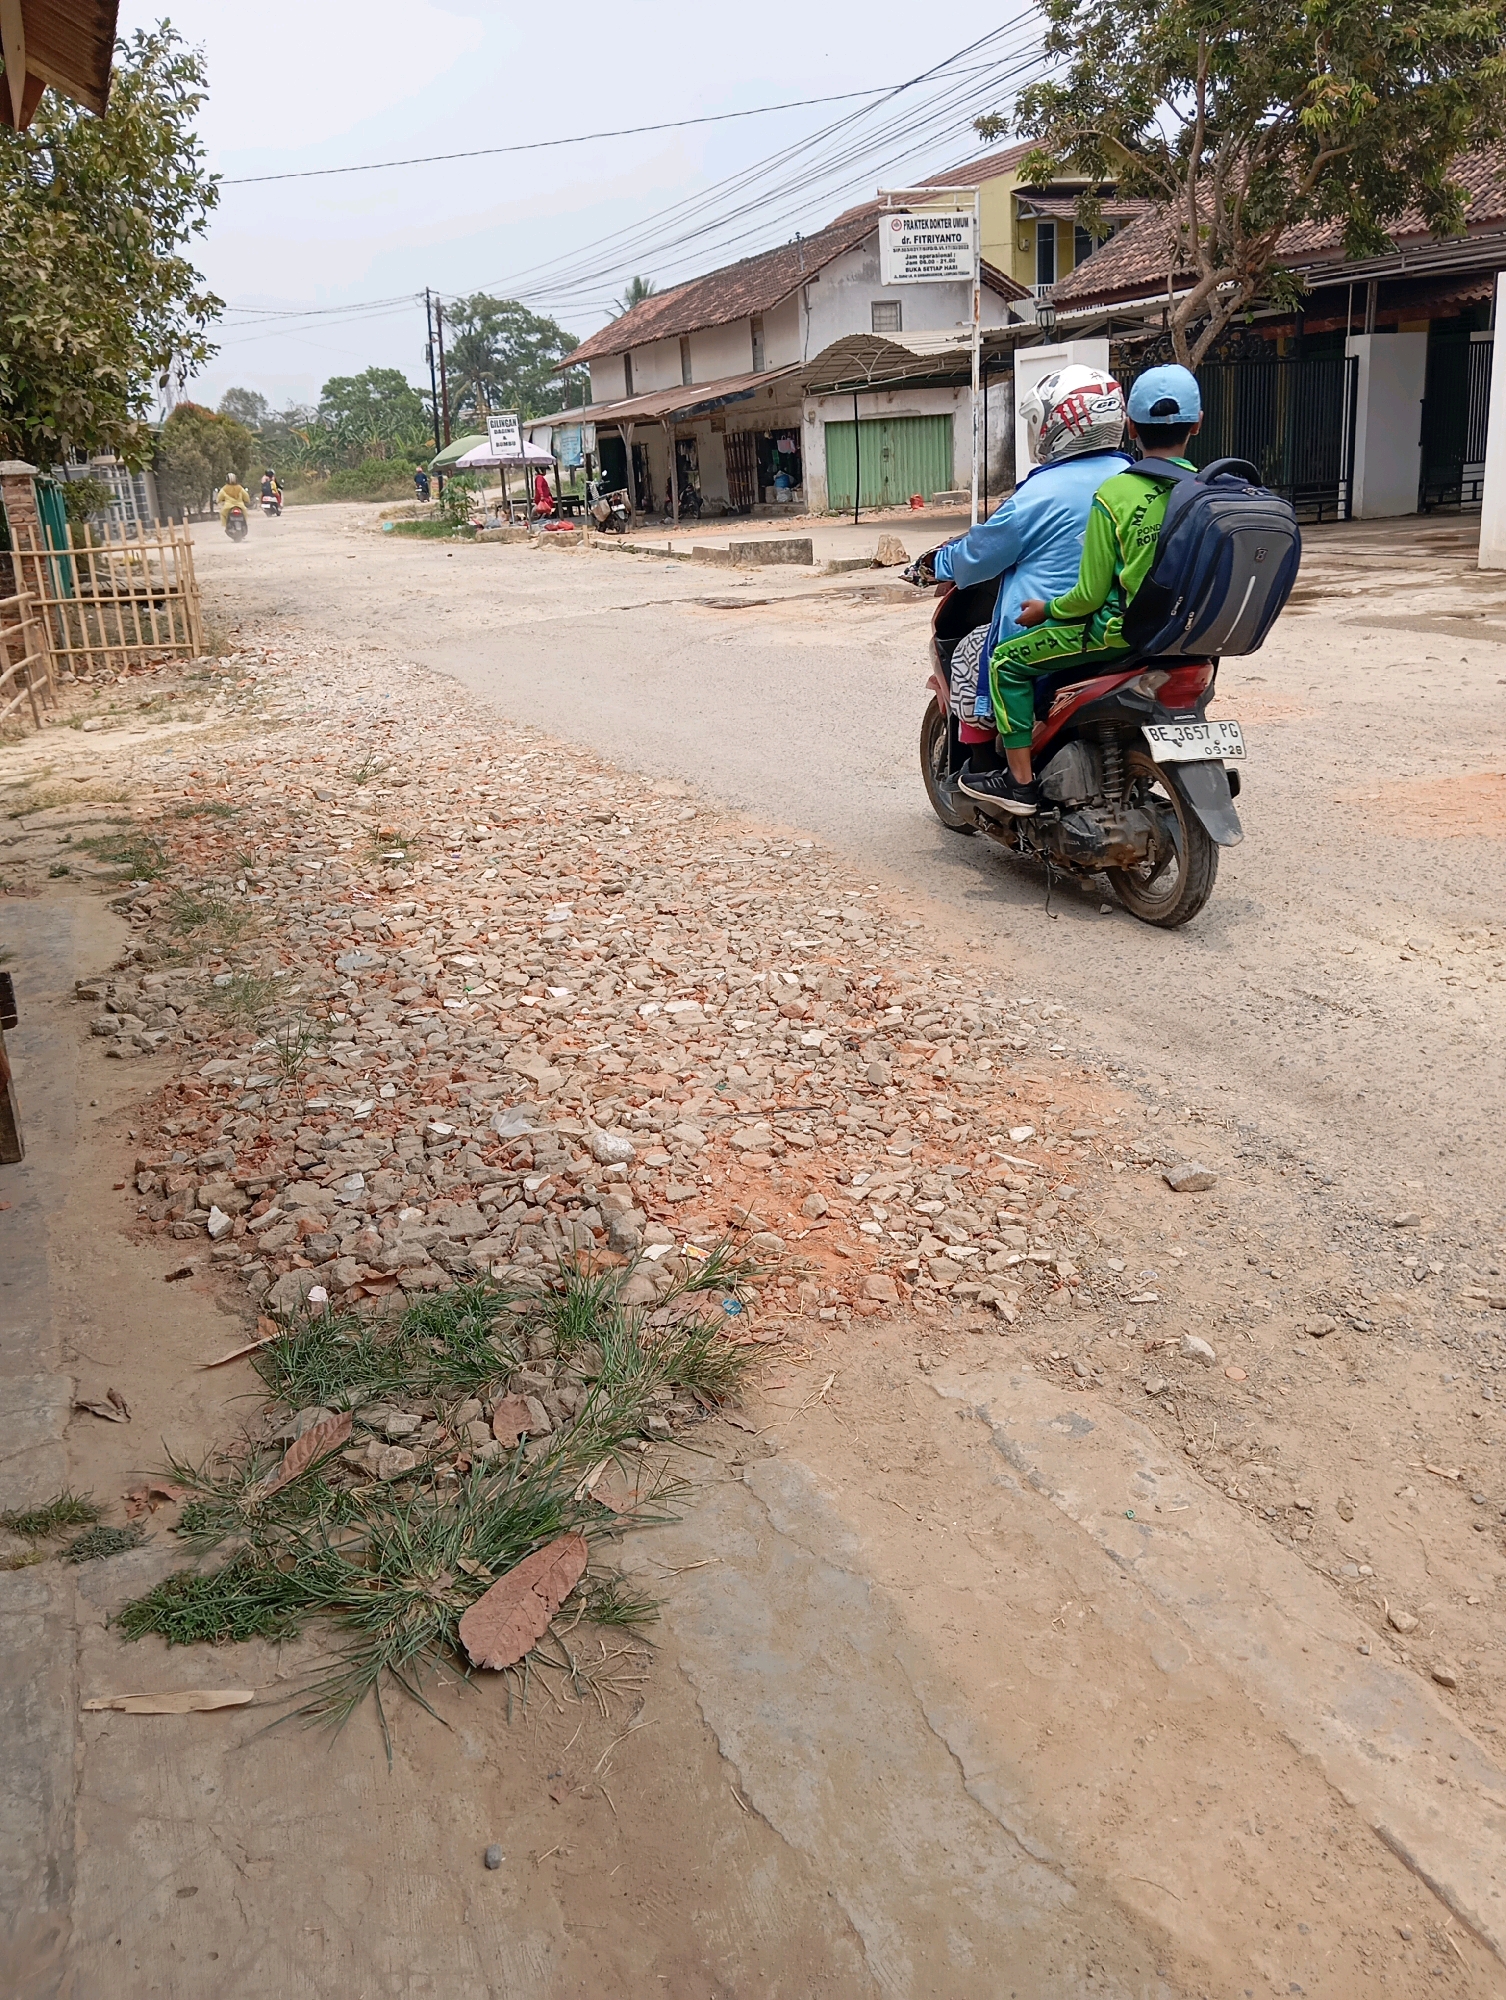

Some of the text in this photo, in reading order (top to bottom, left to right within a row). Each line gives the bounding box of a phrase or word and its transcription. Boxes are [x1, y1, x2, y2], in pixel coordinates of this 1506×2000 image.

[904, 217, 969, 230] PRAKTEK DOKTER UMUM
[902, 233, 962, 245] dr. FITRIYANTO
[490, 419, 517, 428] GILINGAN
[1131, 505, 1148, 527] MI
[1148, 723, 1238, 741] BE 3657 PG
